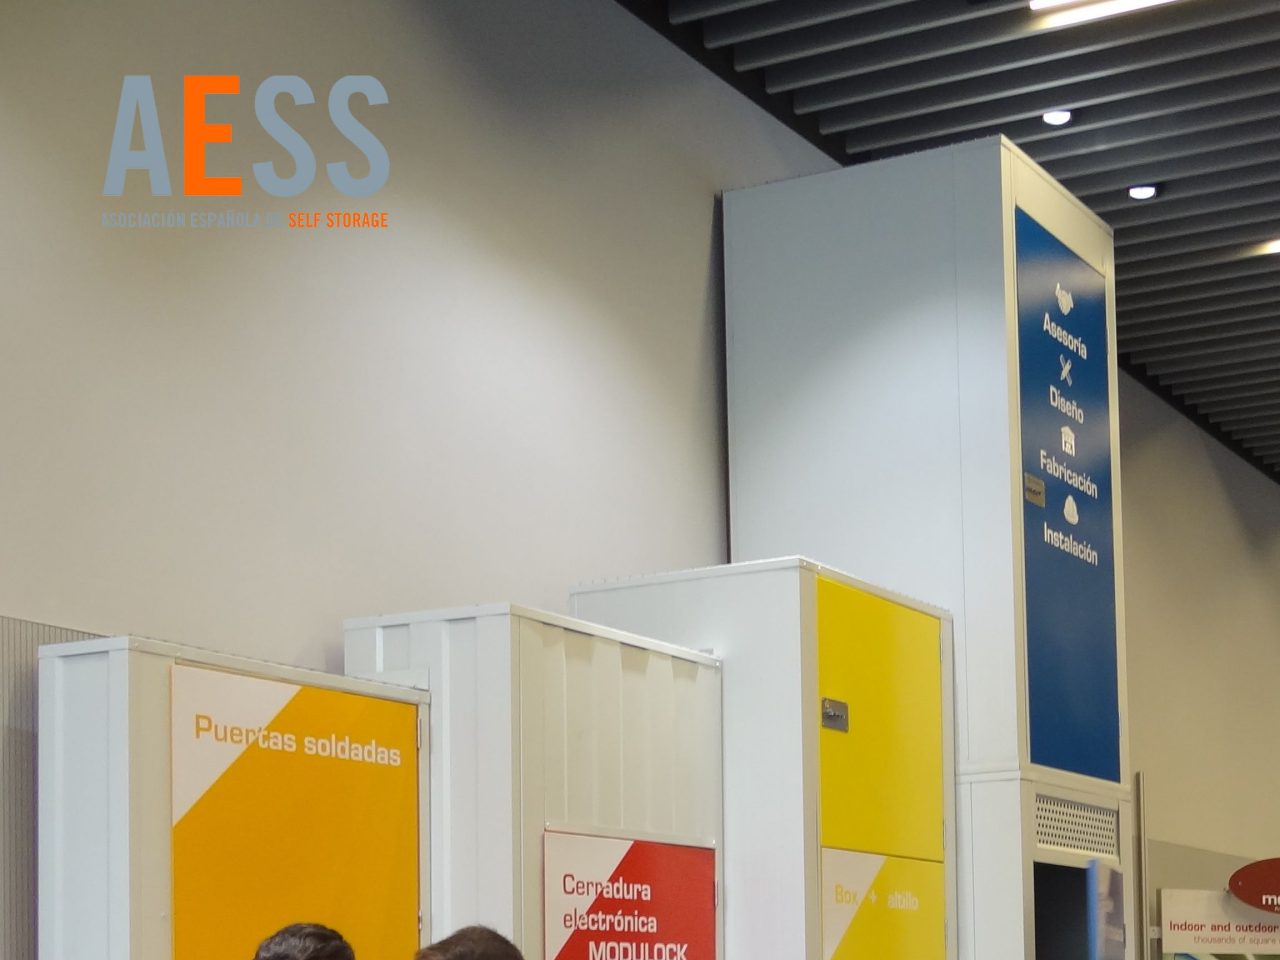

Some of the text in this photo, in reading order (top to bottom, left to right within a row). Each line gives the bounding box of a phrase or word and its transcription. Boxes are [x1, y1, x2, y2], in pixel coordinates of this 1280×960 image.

[1043, 311, 1087, 360] Asesoría
[1049, 384, 1084, 424] Diseño
[1040, 449, 1098, 499] Fabricación
[1044, 521, 1098, 567] Instalación
[195, 714, 401, 767] Puertas soldadas
[563, 874, 651, 901] Cerradura
[834, 884, 858, 905] Box
[563, 908, 657, 933] electrónica
[1169, 920, 1206, 932] Indoor
[1210, 922, 1231, 933] and
[1235, 922, 1279, 934] outdoor
